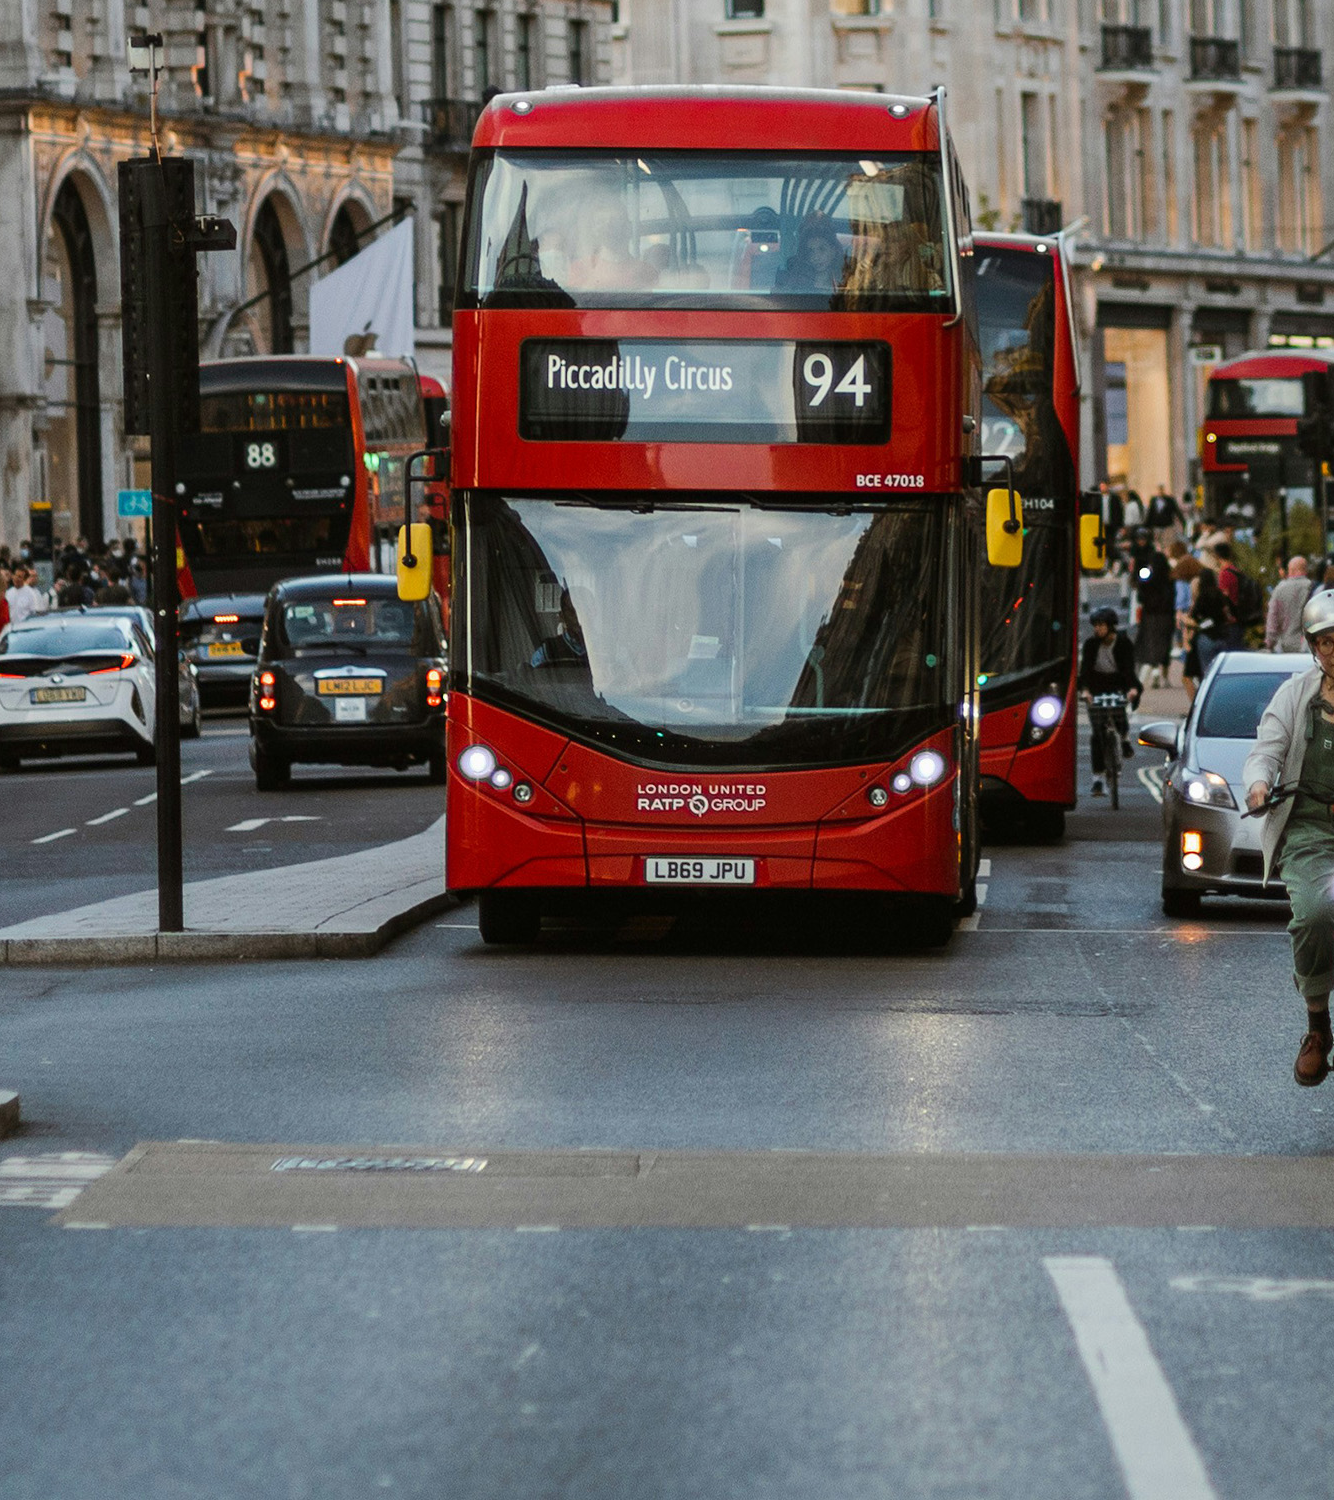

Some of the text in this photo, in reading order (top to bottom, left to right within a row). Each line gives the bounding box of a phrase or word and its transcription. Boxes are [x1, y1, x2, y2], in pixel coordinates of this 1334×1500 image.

[547, 354, 733, 400] Piccadilly Circus
[803, 353, 871, 407] 94
[982, 420, 1015, 458] 2
[247, 443, 276, 468] 88
[856, 474, 925, 488] BCE 47018
[637, 784, 767, 795] LONDON UNITED
[637, 798, 767, 812] RATP GROUP
[654, 861, 746, 880] LB69 JPU
